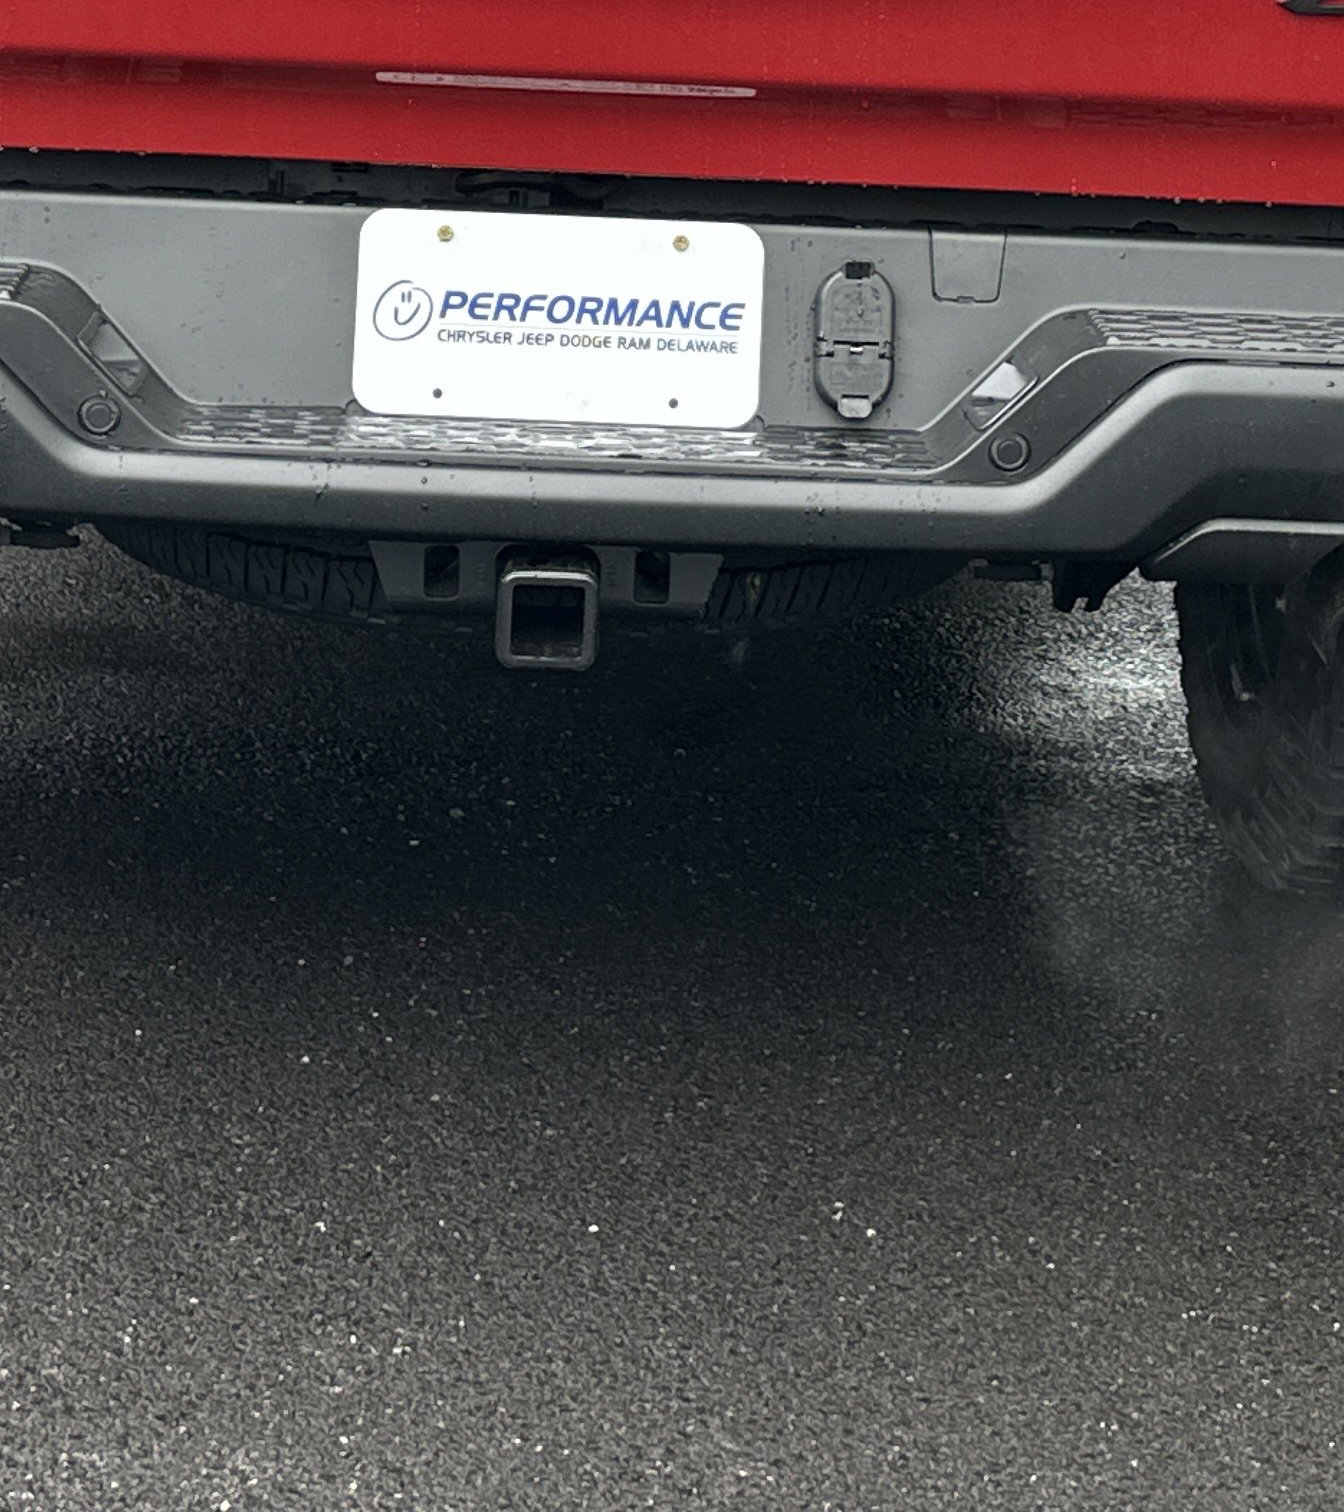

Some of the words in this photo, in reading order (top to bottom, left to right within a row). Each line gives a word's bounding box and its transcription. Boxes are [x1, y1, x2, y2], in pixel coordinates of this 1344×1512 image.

[439, 290, 746, 331] PERFORMANCE
[437, 329, 512, 345] CHRYSLER
[517, 332, 555, 346] JEEP
[559, 334, 612, 349] DODGE
[617, 336, 651, 350] RAM
[656, 338, 739, 354] DELAWARE
